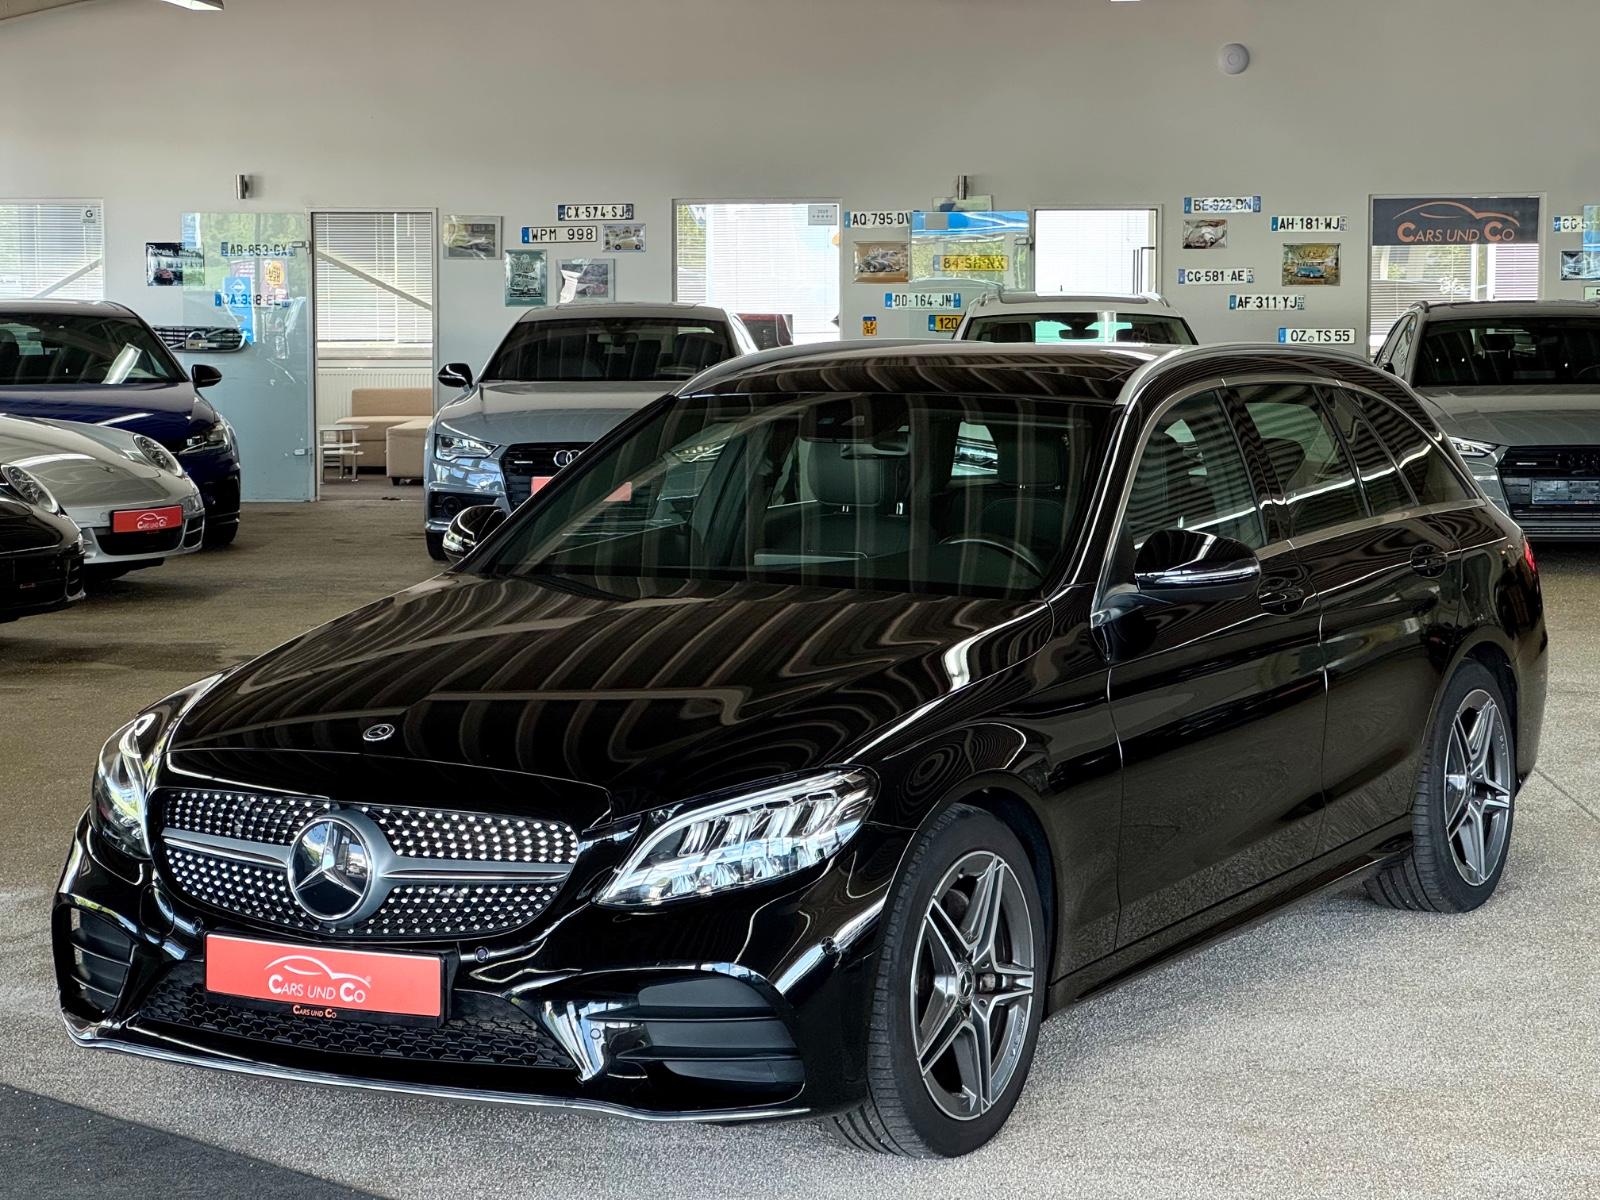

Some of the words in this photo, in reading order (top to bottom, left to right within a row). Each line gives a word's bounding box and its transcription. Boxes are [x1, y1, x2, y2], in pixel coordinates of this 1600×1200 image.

[566, 206, 625, 218] CX-574-SJ
[1279, 217, 1340, 230] AH-181-WJ
[531, 228, 557, 241] WPM
[567, 228, 594, 240] 998
[1446, 228, 1480, 242] UND
[229, 244, 287, 257] AB-853-GX
[1187, 270, 1245, 282] CG-581-AE
[894, 294, 952, 307] DD-164-JN
[1237, 296, 1297, 308] AF-311-YJ
[307, 985, 336, 1000] UND
